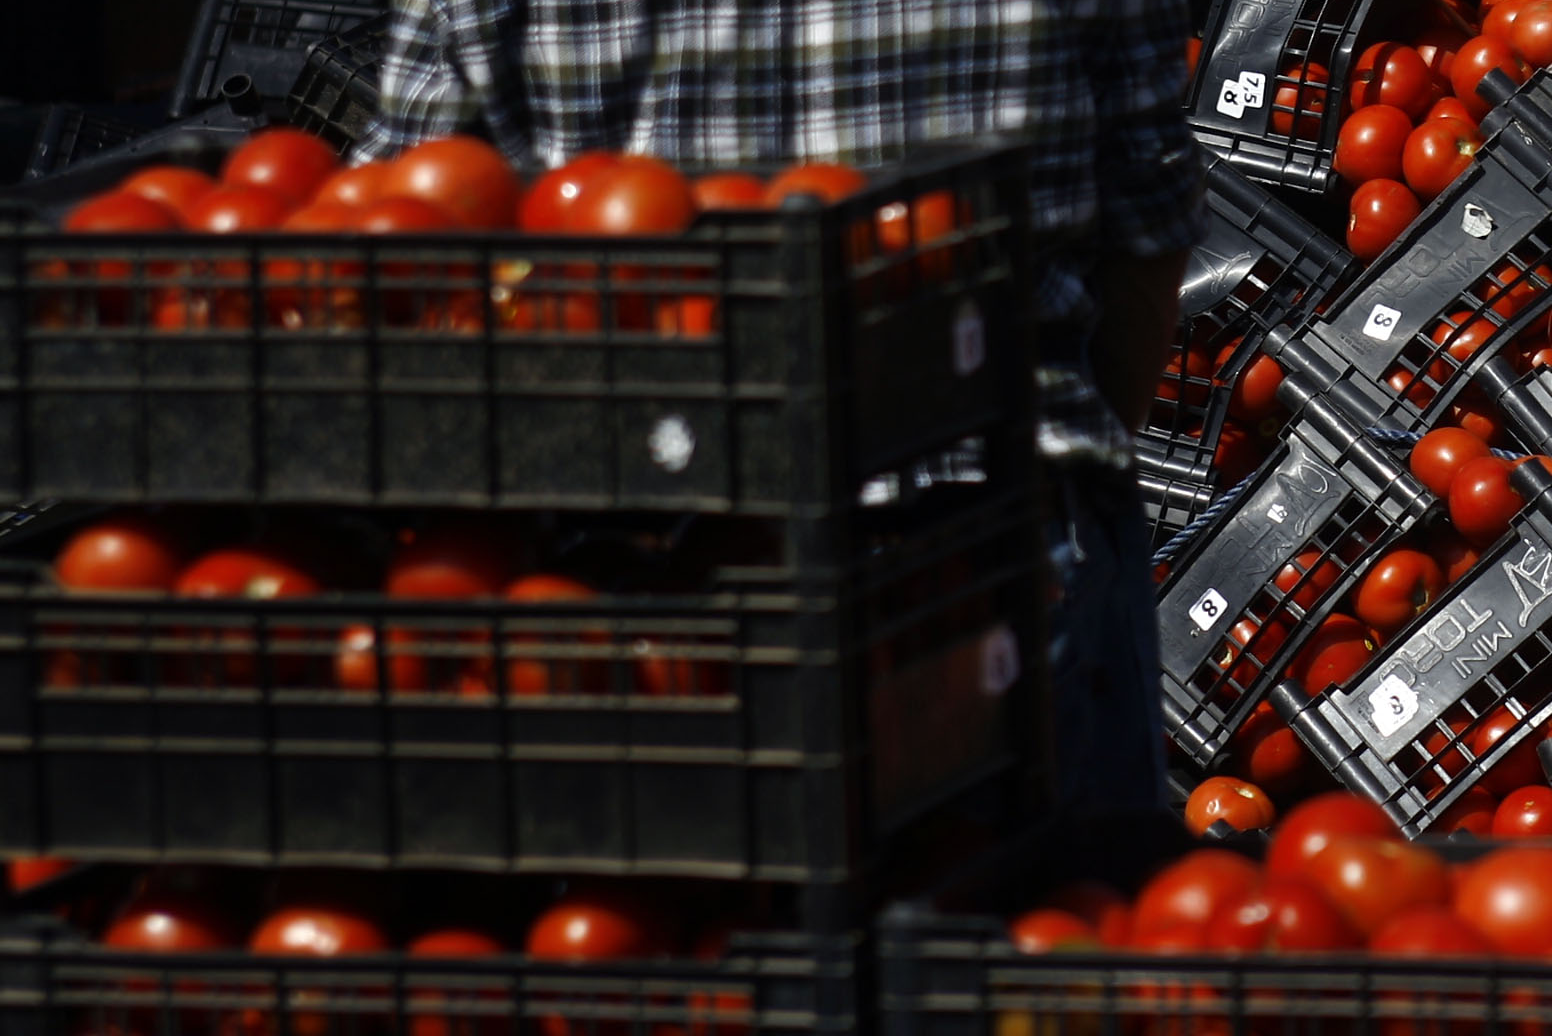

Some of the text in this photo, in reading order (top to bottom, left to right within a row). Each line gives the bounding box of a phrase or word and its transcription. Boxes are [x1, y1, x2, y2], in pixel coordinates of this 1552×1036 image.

[1374, 313, 1393, 327] 8
[1202, 599, 1218, 617] 8
[1451, 620, 1514, 680] MINI
